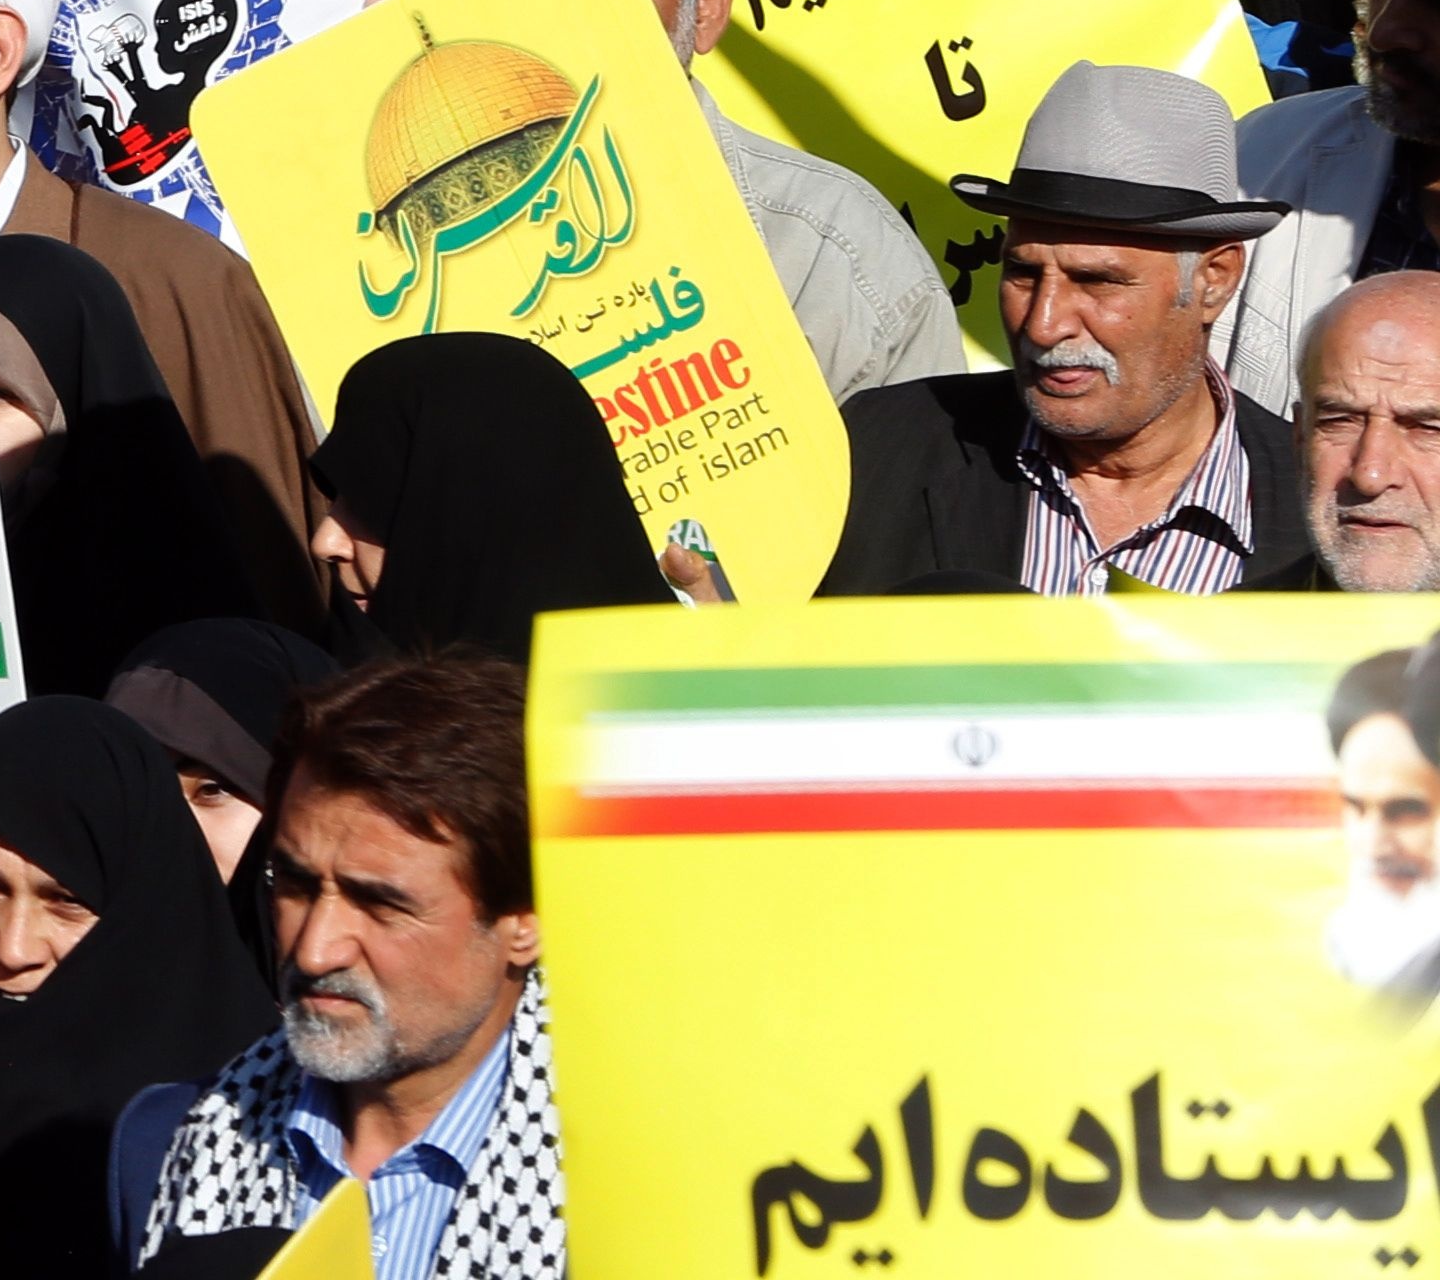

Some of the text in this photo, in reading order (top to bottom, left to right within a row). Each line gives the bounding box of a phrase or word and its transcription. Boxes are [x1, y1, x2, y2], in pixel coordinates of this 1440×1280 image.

[172, 12, 228, 52] داعش
[700, 392, 769, 438] Part
[659, 466, 689, 504] of
[702, 425, 789, 481] islam
